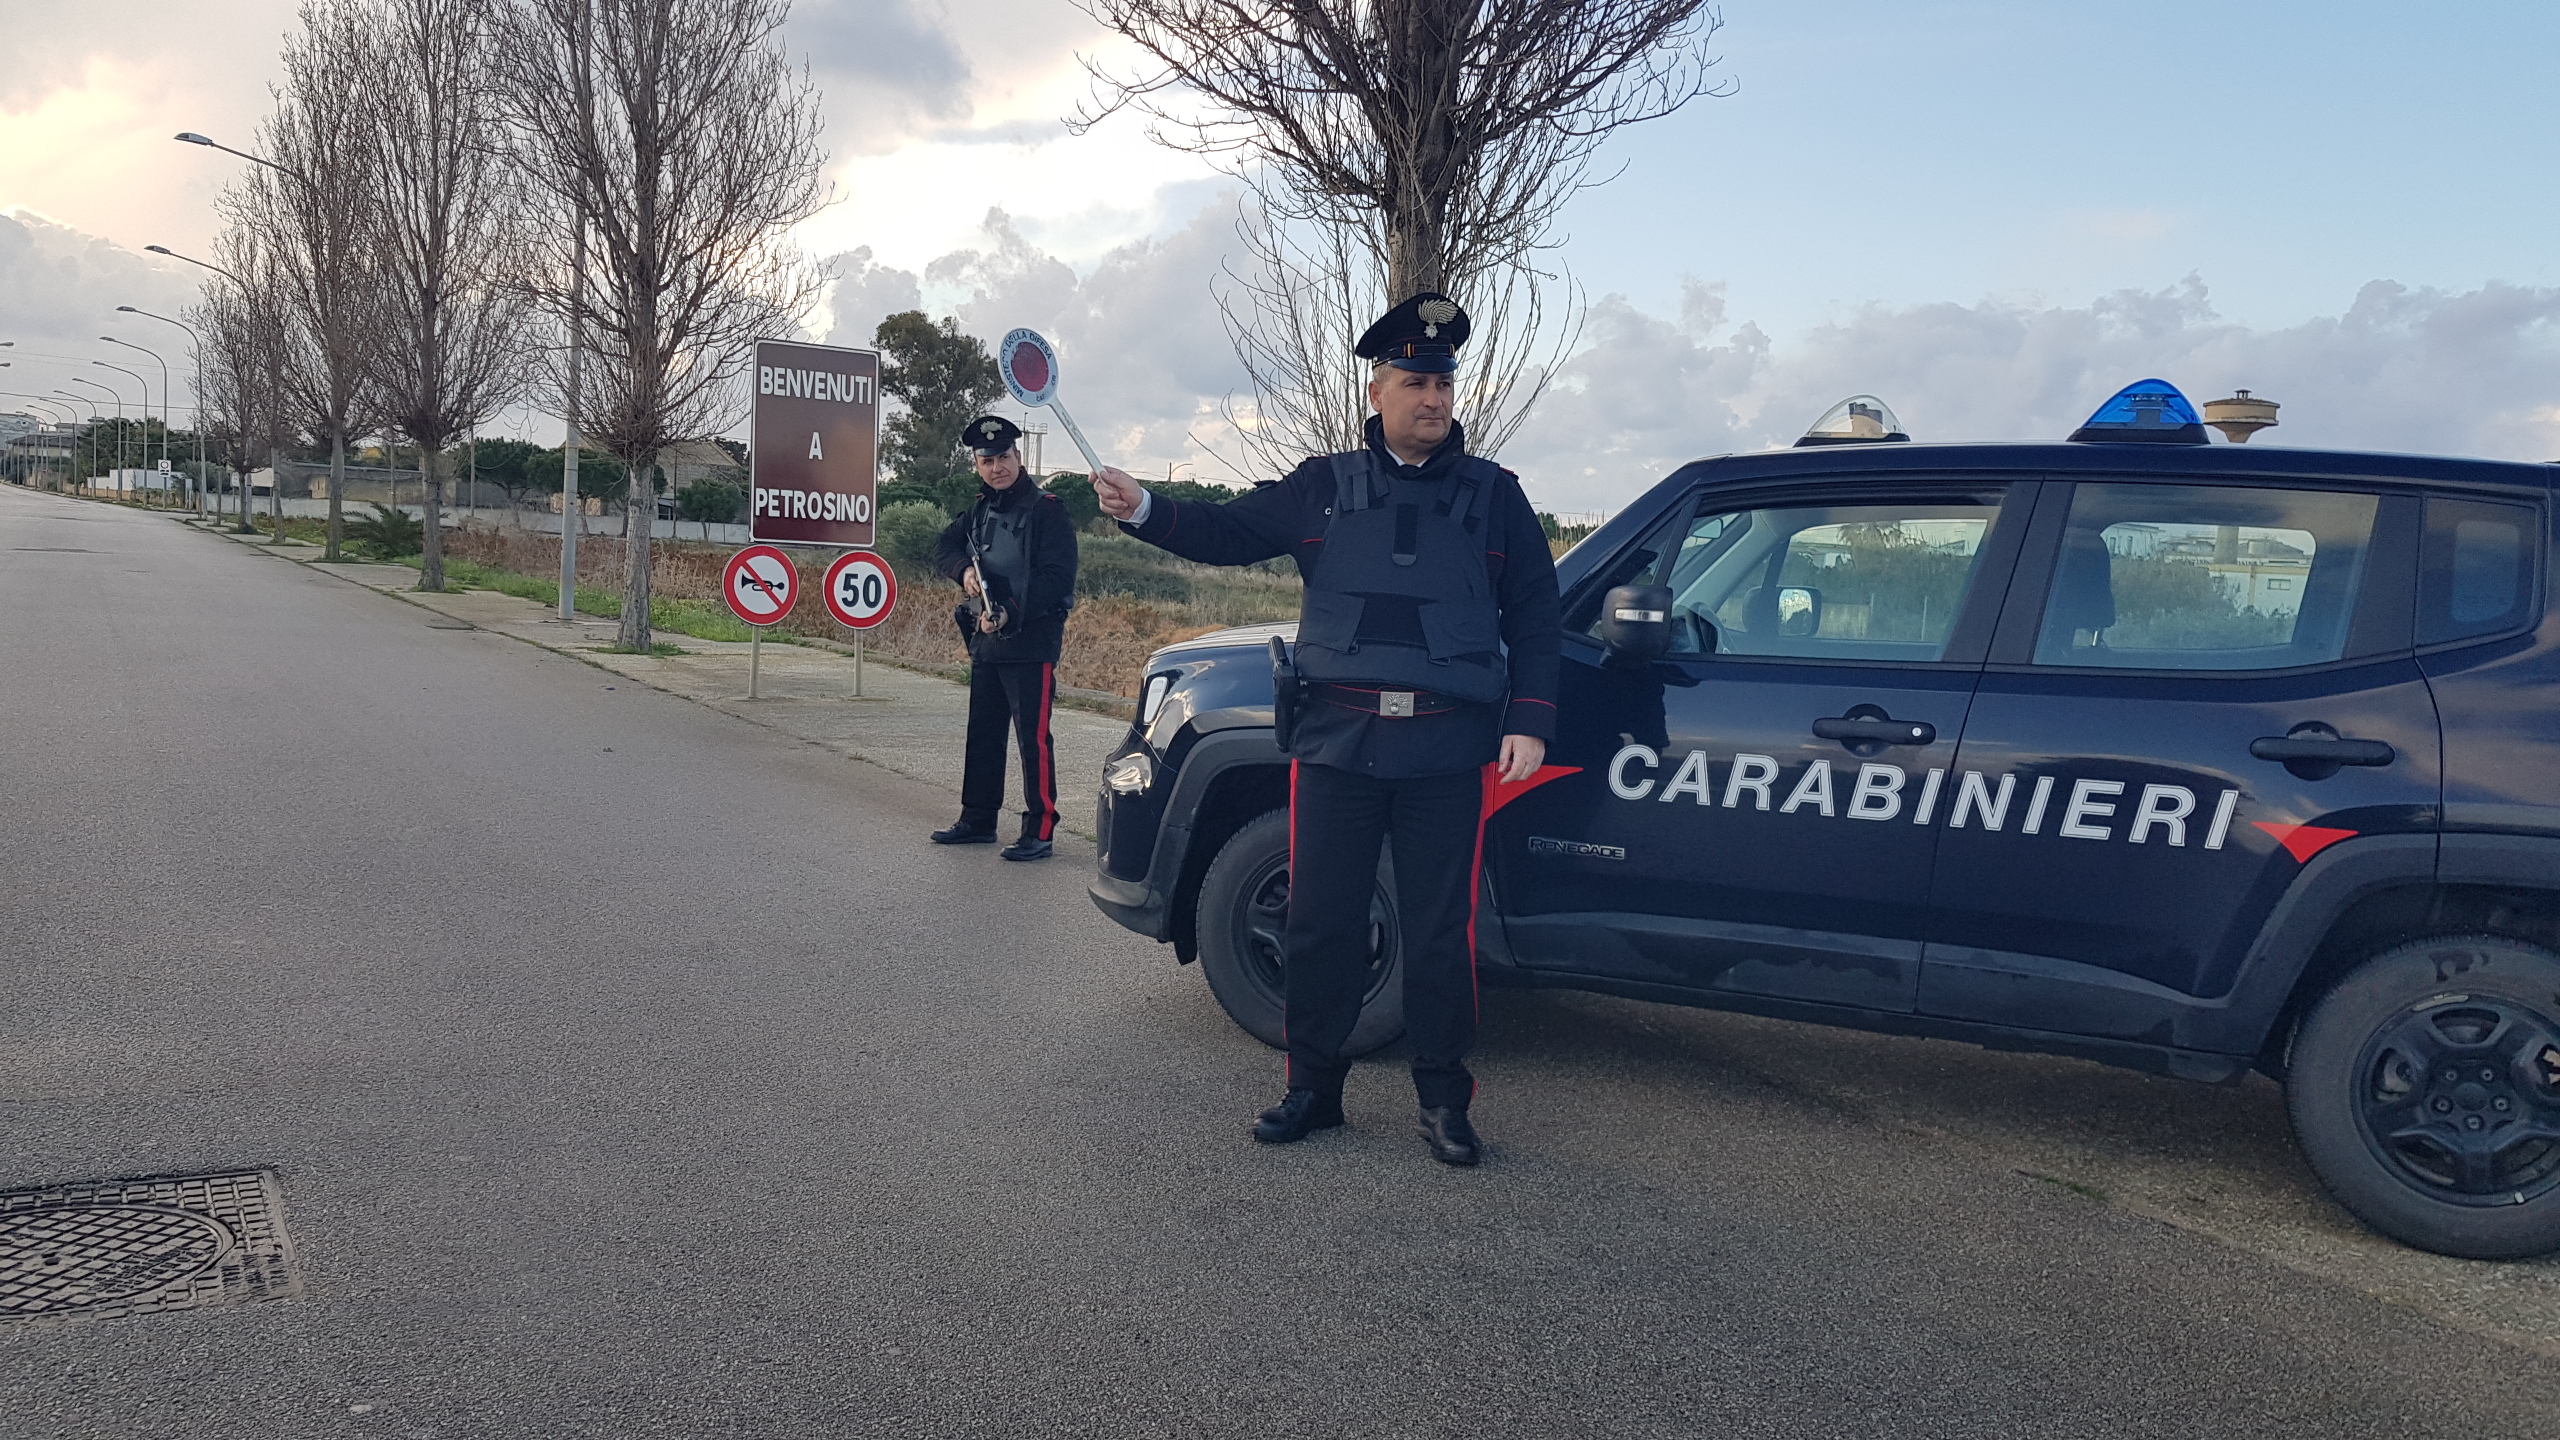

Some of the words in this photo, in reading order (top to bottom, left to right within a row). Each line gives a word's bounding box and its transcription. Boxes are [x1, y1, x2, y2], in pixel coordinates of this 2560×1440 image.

[1029, 332, 1052, 360] DIFESA
[760, 365, 873, 405] BENVENUTI
[808, 431, 823, 460] A
[755, 487, 870, 523] PETROSINO
[841, 573, 882, 609] 50
[1607, 743, 2240, 850] CARABINIERI
[1529, 837, 1625, 860] RENEGADE
